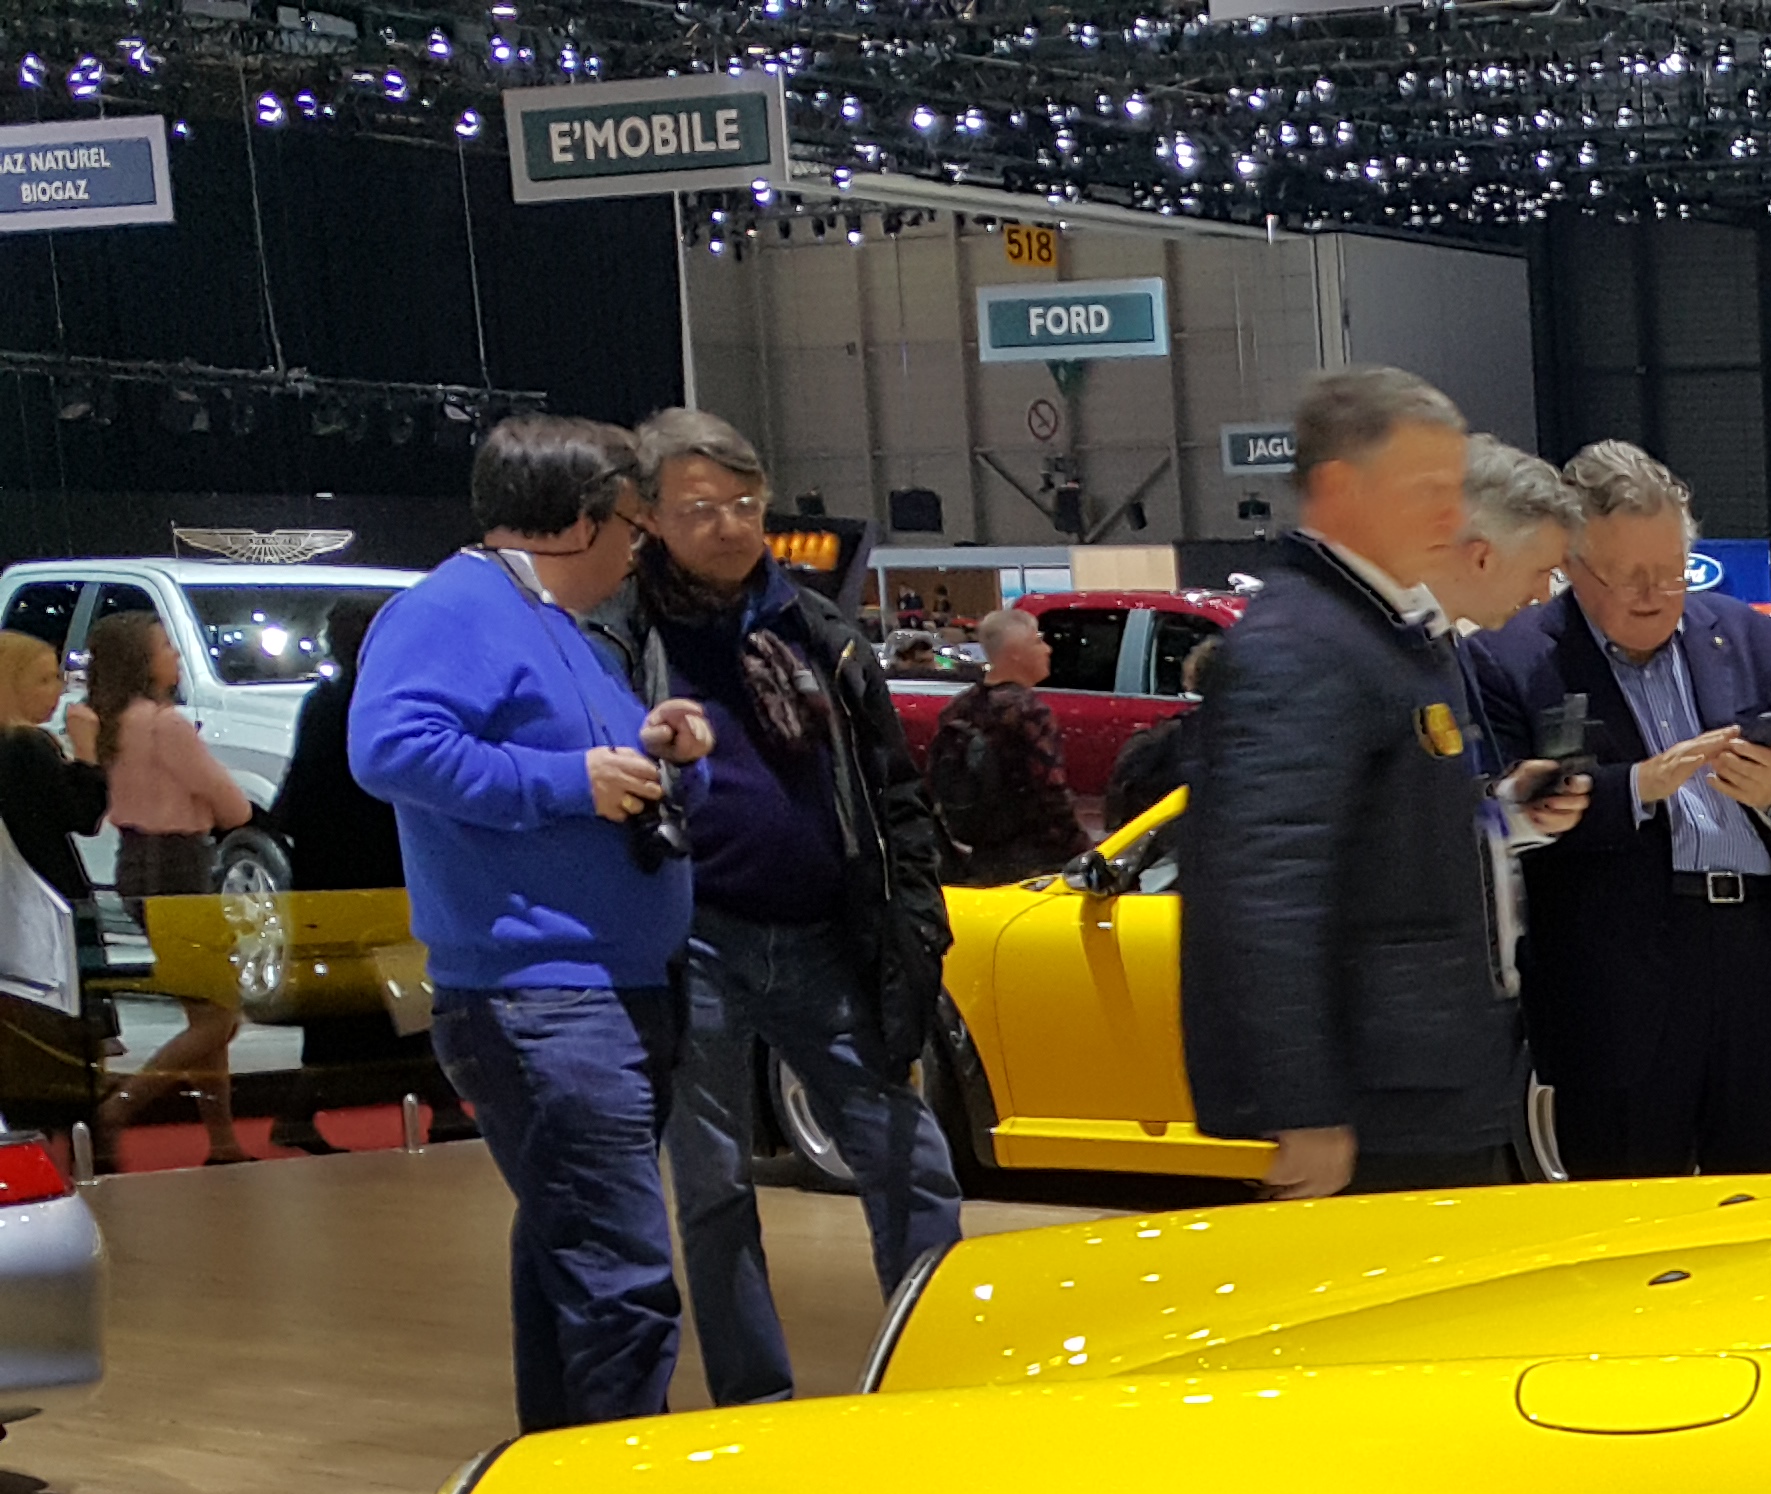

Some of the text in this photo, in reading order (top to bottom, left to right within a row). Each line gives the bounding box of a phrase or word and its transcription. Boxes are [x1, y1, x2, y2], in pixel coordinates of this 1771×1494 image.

[549, 108, 741, 163] E'MOBILE
[30, 147, 111, 172] NATUREL
[21, 179, 89, 204] BIOGAZ
[1007, 228, 1053, 263] 518
[1029, 304, 1109, 336] FORD
[1246, 437, 1297, 462] JAGU
